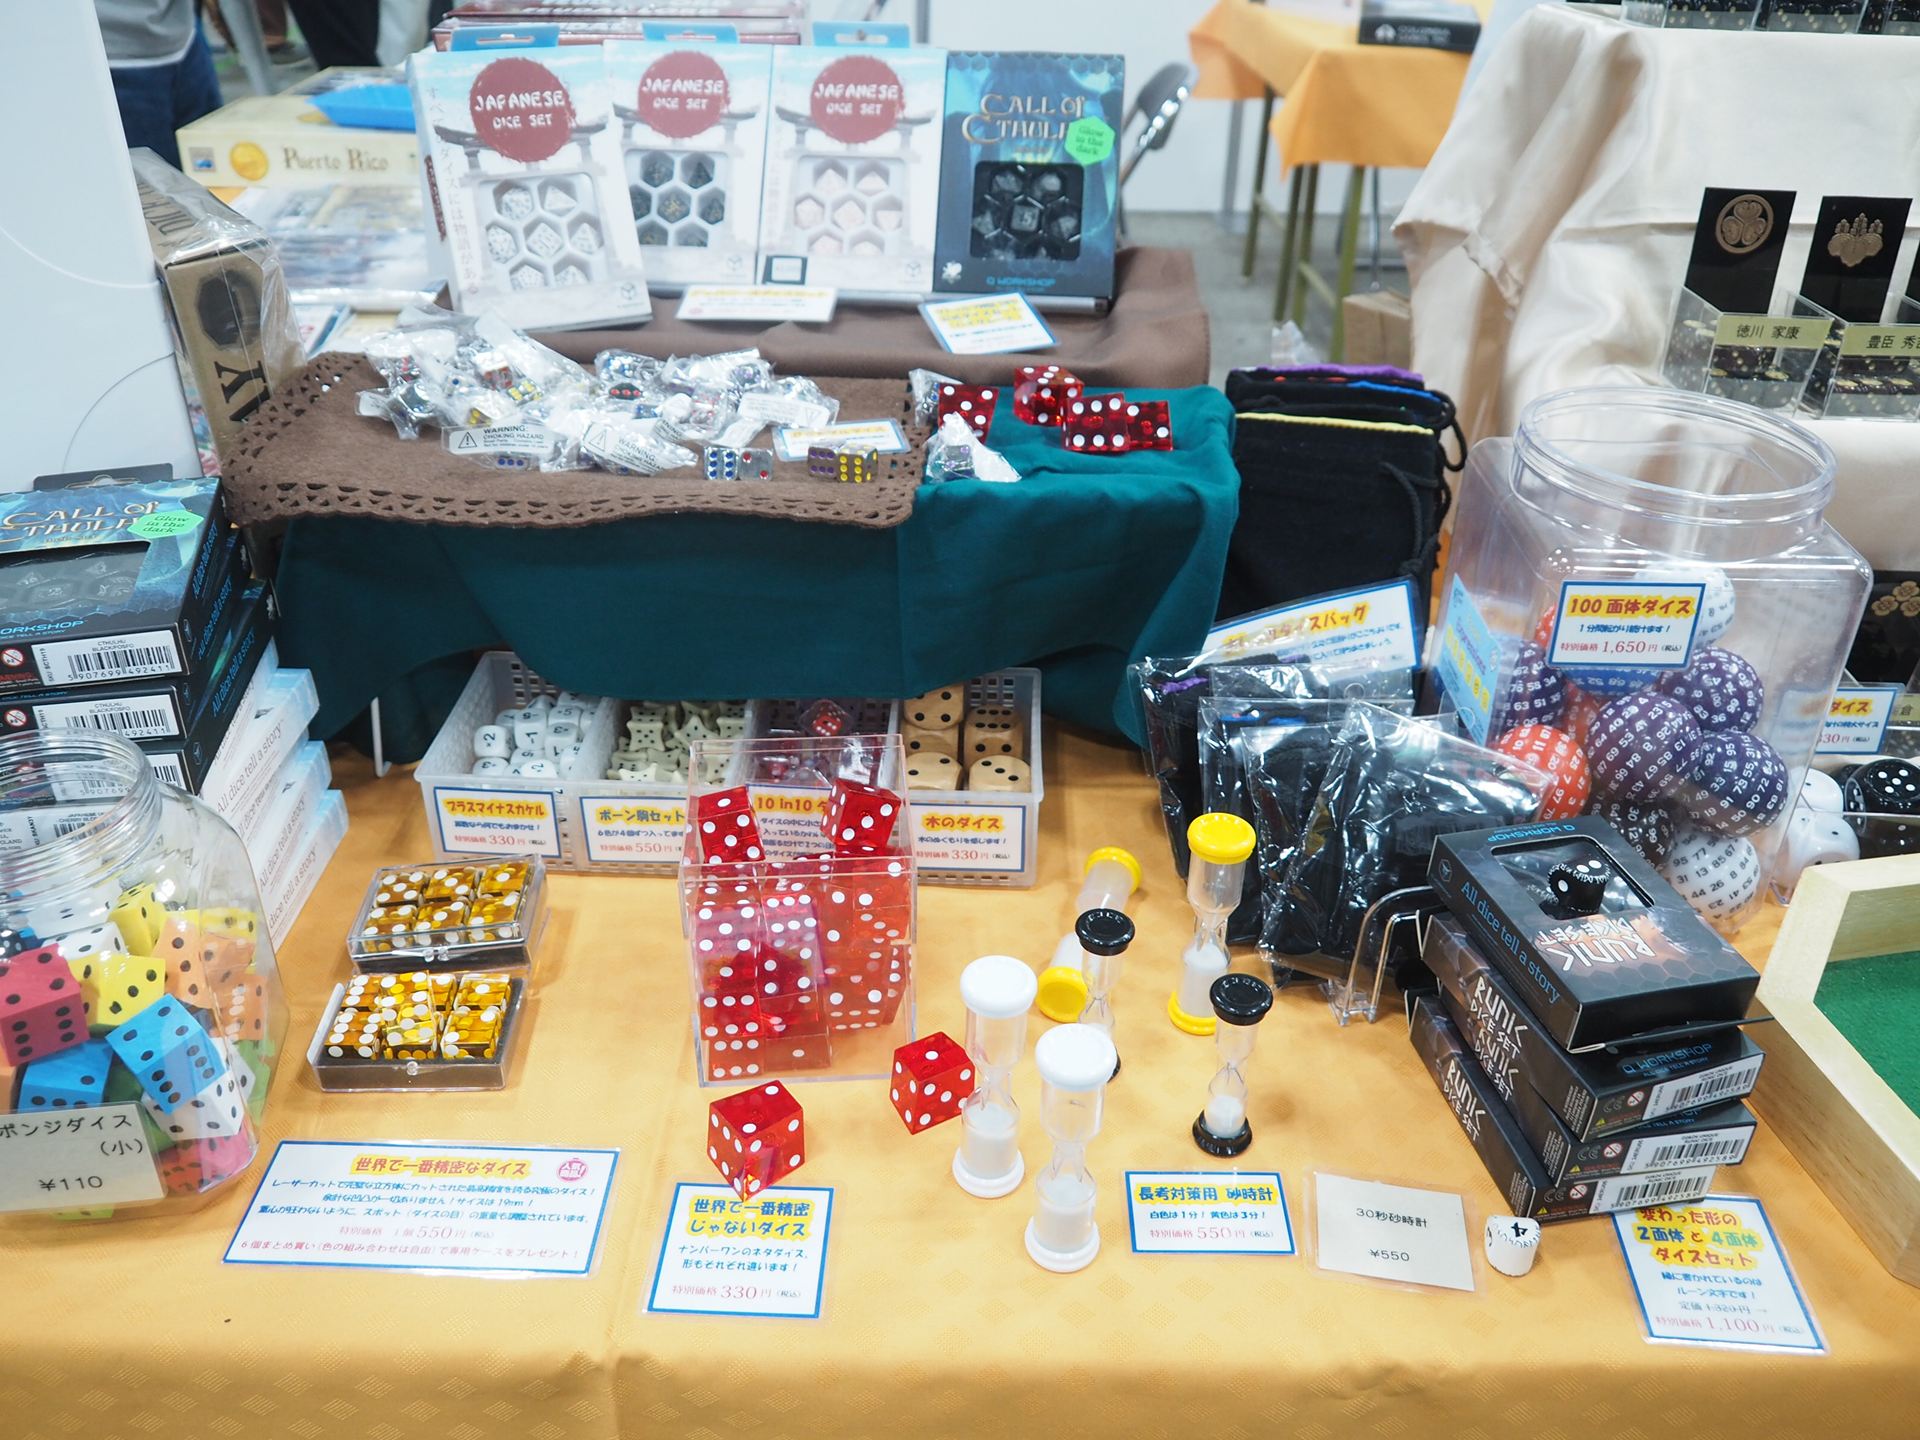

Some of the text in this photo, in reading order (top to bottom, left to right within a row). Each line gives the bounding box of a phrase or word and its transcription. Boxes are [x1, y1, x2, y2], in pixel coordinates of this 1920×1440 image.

[642, 78, 724, 93] JAPANESE
[814, 83, 899, 100] JAPANESE
[475, 91, 565, 111] JAPANESE
[653, 97, 709, 109] DICE SET
[826, 102, 882, 114] DICE SET
[980, 93, 1055, 116] CALL
[493, 113, 552, 128] DICE SET
[282, 144, 389, 172] Puerto Rico
[1736, 324, 1801, 340] 徳川 家康
[1866, 336, 1895, 349] 豊臣
[3, 506, 114, 527] CALL
[154, 514, 190, 522] Glow
[128, 664, 171, 675] 492411
[1544, 675, 1557, 687] 34
[1514, 701, 1529, 711] 63
[1534, 698, 1546, 708] 51
[1648, 706, 1663, 720] 23
[1711, 713, 1727, 724] 36
[125, 728, 166, 737] 492411
[1609, 718, 1624, 733] 40
[1618, 732, 1634, 748] 53
[1642, 741, 1653, 752] 8
[217, 792, 230, 814] All
[227, 775, 246, 800] dice
[242, 753, 259, 779] tell
[261, 724, 282, 755] story
[1710, 777, 1726, 792] 33
[1733, 779, 1748, 794] 79
[1757, 778, 1770, 793] 72
[1695, 790, 1709, 802] 49
[1720, 796, 1734, 809] 91
[1746, 794, 1761, 809] 90
[446, 801, 545, 817] プラスマイナスカケル
[1628, 806, 1640, 822] 30
[1731, 810, 1747, 822] 50
[926, 815, 1001, 829] 木のダイス
[1487, 826, 1562, 842] WORKSHOP
[1628, 827, 1639, 840] 12
[1692, 848, 1707, 861] 77
[1724, 844, 1736, 857] 67
[1673, 856, 1688, 867] 95
[1711, 856, 1727, 869] 85
[1676, 875, 1688, 885] 31
[1695, 867, 1709, 878] 13
[1730, 870, 1738, 880] 8
[1710, 880, 1724, 892] 26
[1691, 889, 1706, 899] 44
[1460, 882, 1480, 904] All
[1478, 900, 1500, 932] dice
[1500, 927, 1520, 954] tell
[1527, 962, 1563, 1006] story
[1538, 927, 1575, 948] SET
[1547, 933, 1657, 972] RUNIC
[1474, 976, 1529, 1048] RUNIC
[1470, 1002, 1520, 1058] DICE SET
[1622, 1043, 1714, 1074] Q WORKSHOP
[1475, 1039, 1513, 1101] DICE SET
[1447, 1058, 1486, 1131] RUNIC
[1444, 1079, 1481, 1141] DICE SET
[355, 1157, 528, 1176] 世界で一番精密なダイス
[39, 1175, 103, 1191] ¥110
[1139, 1187, 1273, 1201] 長考対策用 砂時計
[694, 1198, 810, 1216] 世界で一番精密
[1356, 1207, 1427, 1228] 30秒砂時計
[1642, 1208, 1738, 1226] 変わった形の
[691, 1219, 805, 1236] じゃないダイス
[1369, 1248, 1410, 1262] ¥550
[1656, 1247, 1753, 1266] ダイスセット
